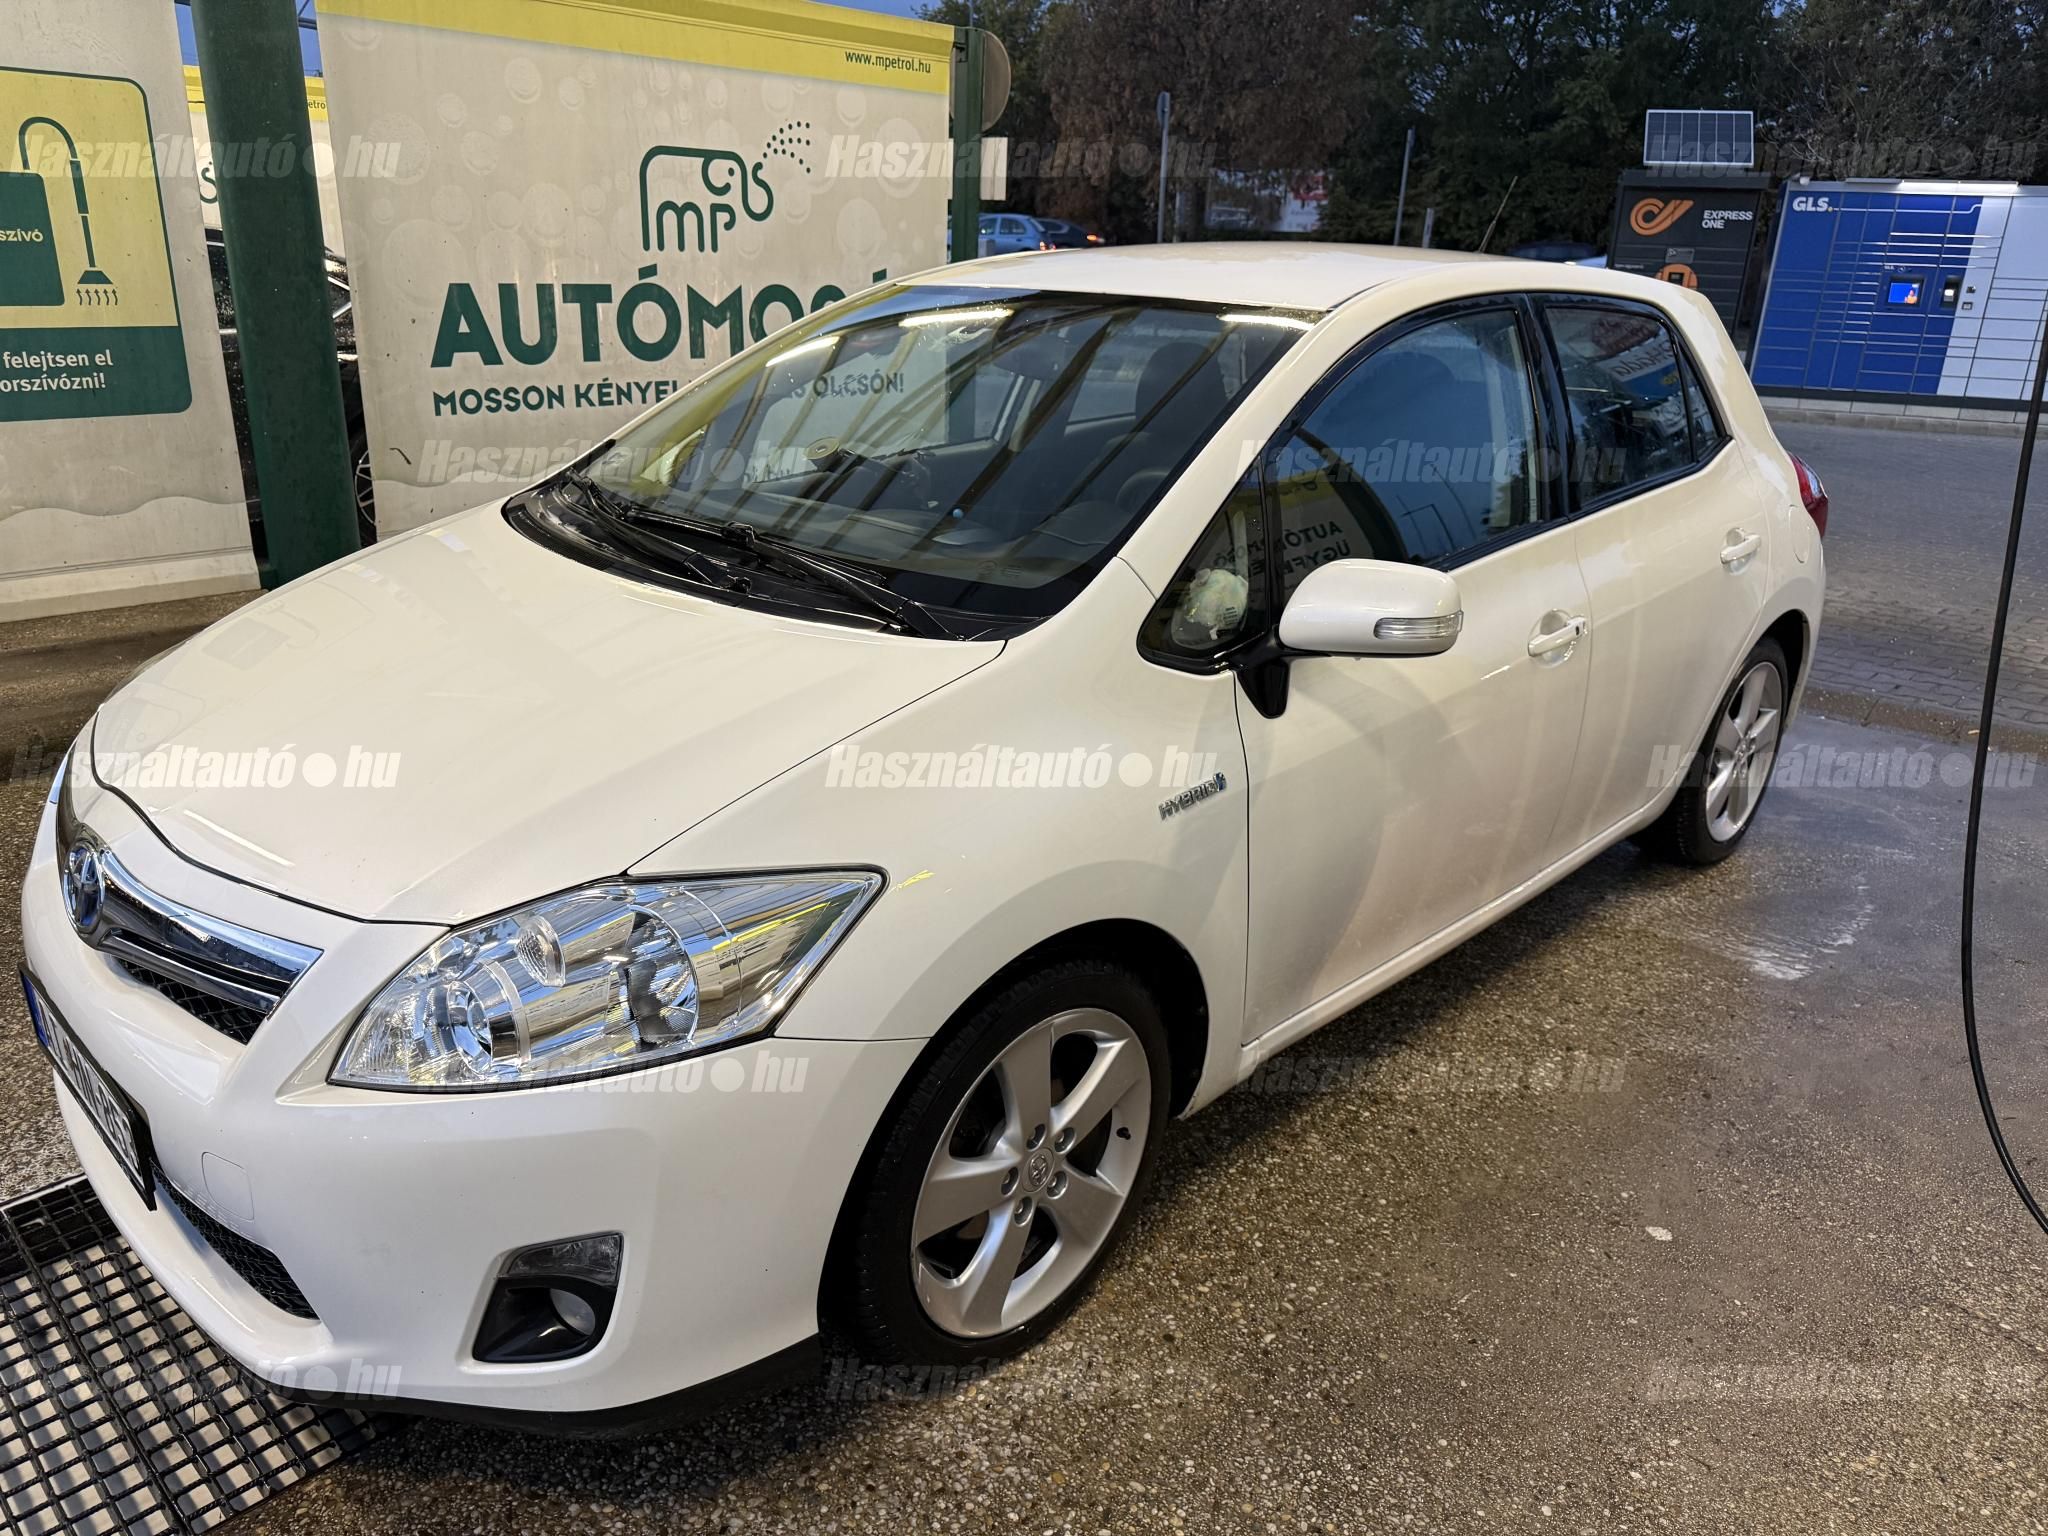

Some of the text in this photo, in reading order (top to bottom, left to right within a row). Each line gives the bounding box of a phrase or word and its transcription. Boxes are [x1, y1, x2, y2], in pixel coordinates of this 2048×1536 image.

[844, 50, 932, 73] www.mpetrol.hu
[307, 100, 326, 110] etro
[1702, 219, 1725, 229] ONE
[1703, 210, 1753, 221] EXPRESS
[431, 263, 887, 368] AUTÓMO
[3, 349, 114, 371] felejtsen el
[0, 372, 106, 392] orszívózni!
[433, 384, 565, 416] MOSSON
[1158, 779, 1218, 821] HYBRID
